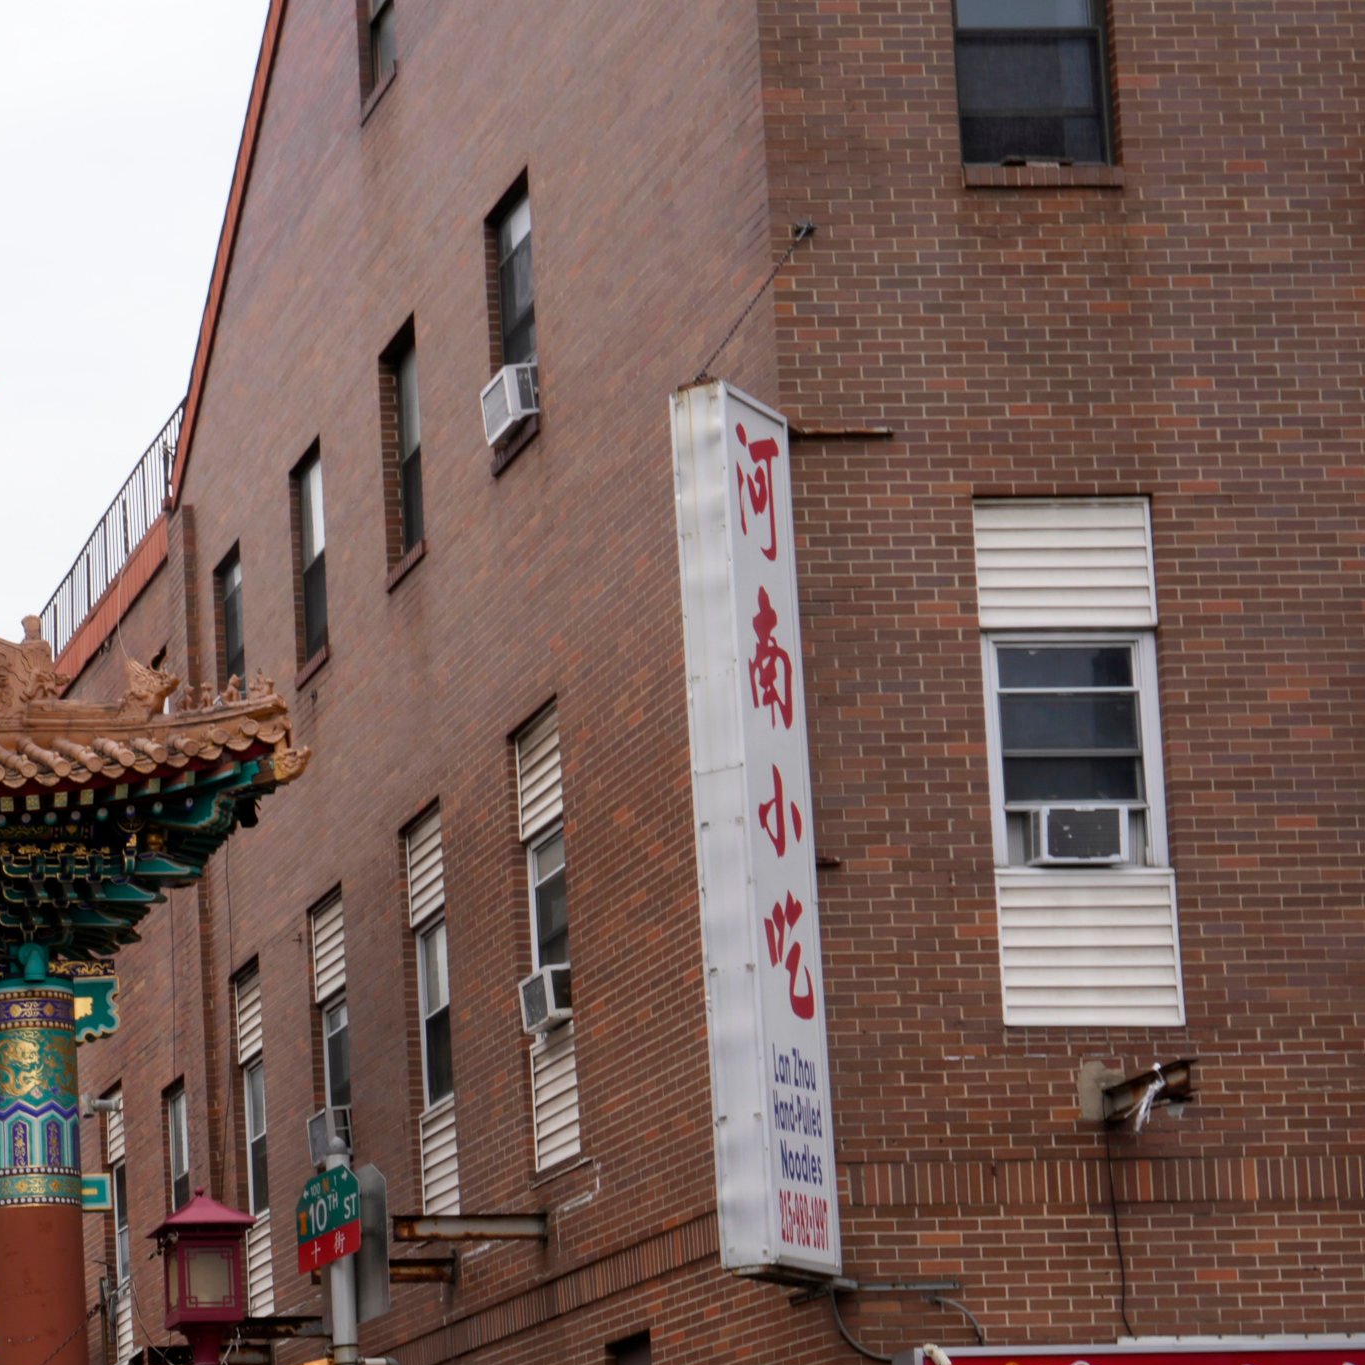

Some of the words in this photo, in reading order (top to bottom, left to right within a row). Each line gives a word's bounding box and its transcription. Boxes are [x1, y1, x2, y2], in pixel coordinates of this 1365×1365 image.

[734, 422, 816, 1022] 河南小吃
[772, 1043, 792, 1084] Lan
[792, 1048, 817, 1092] Zhou
[773, 1090, 823, 1139] Hand-Pulled
[780, 1139, 823, 1187] Noodles
[308, 1191, 339, 1235] 10TH
[343, 1193, 357, 1220] ST
